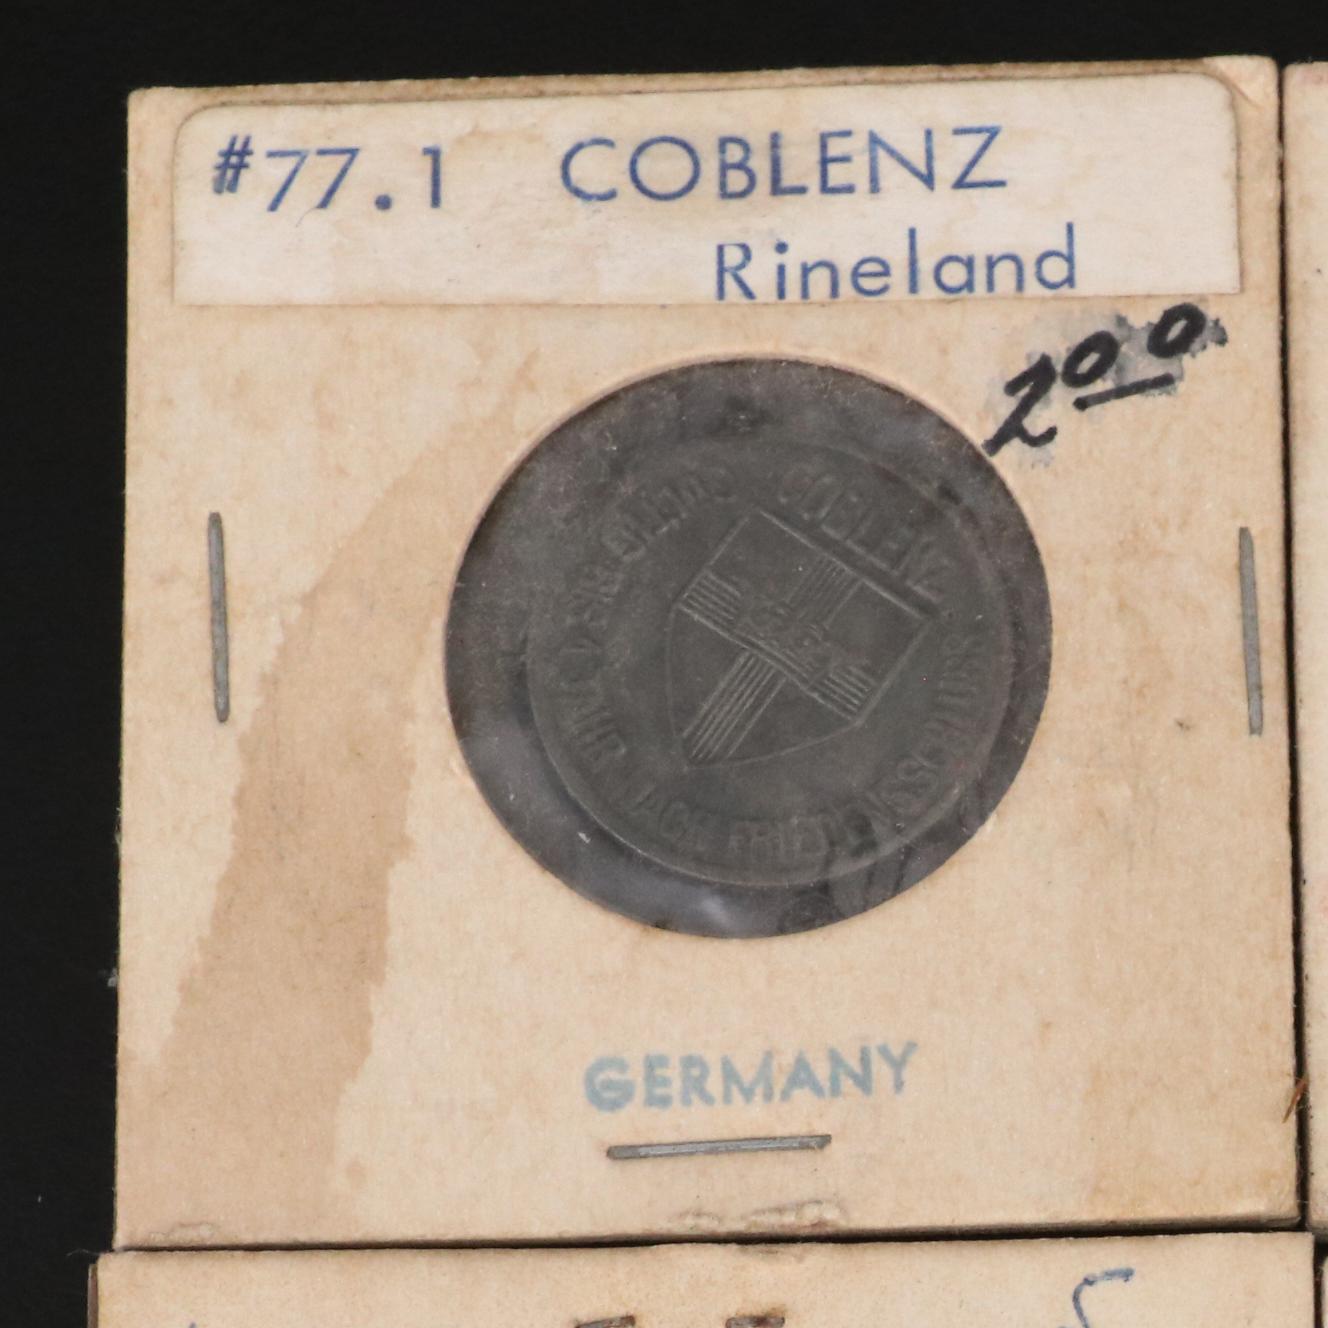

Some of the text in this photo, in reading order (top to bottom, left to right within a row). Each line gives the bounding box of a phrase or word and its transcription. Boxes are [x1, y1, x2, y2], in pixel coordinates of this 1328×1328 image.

[211, 124, 1009, 213] #77.1 COBLENZ
[713, 223, 1079, 304] Rineland
[583, 1040, 918, 1113] GERMANY
